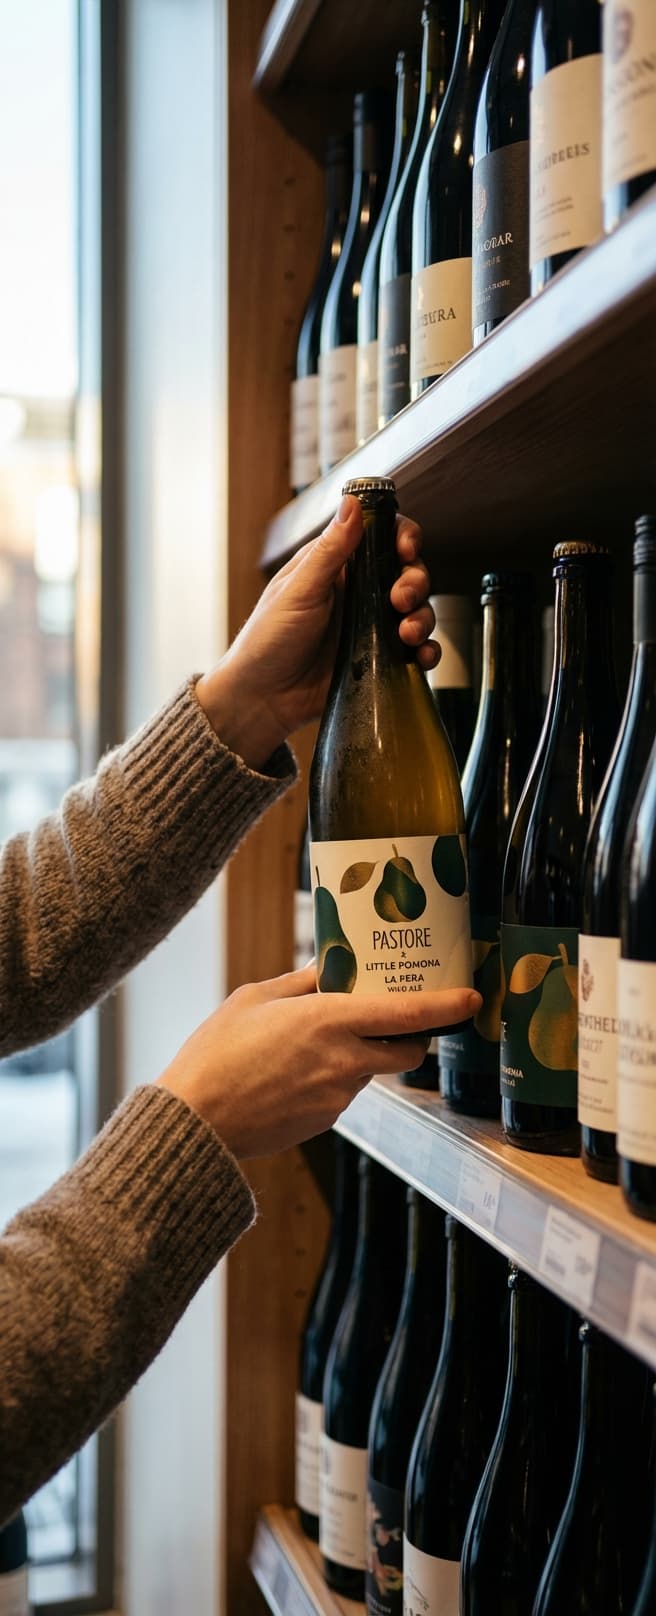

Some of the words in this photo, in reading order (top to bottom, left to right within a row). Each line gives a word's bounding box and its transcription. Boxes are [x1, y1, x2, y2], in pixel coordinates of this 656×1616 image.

[372, 927, 432, 950] PASTORE
[366, 961, 396, 971] LITTLE
[398, 959, 440, 969] POMONA
[385, 975, 397, 984] LA
[399, 974, 424, 983] PERA
[408, 984, 423, 992] ALE
